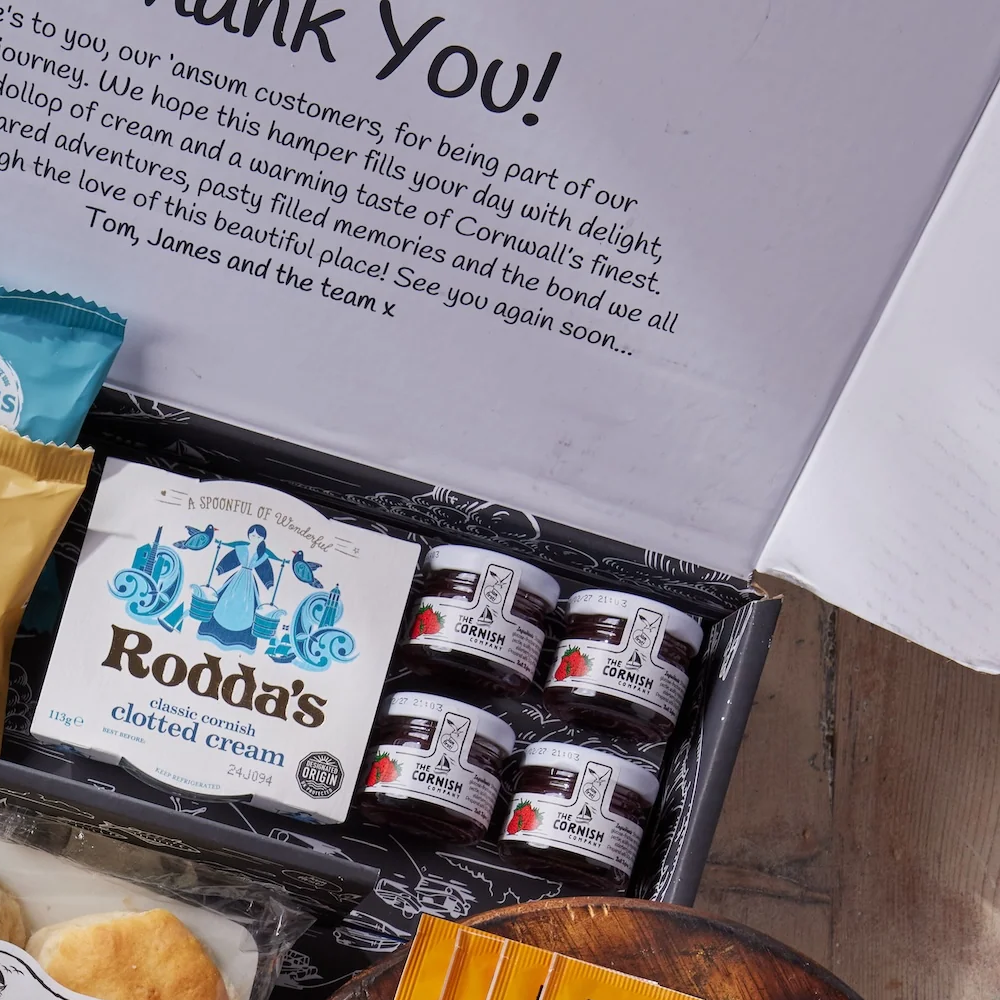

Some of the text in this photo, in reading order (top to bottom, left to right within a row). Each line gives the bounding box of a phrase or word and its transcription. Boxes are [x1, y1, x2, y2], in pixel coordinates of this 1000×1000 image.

[145, 0, 562, 126] ank You!
[32, 12, 56, 37] to
[60, 28, 109, 62] you,
[119, 46, 161, 68] our
[170, 53, 247, 97] 'ansum
[255, 87, 384, 144] customers,
[395, 122, 432, 150] for
[437, 135, 499, 177] being
[504, 164, 559, 190] part
[564, 178, 595, 199] of
[595, 190, 638, 212] our
[99, 70, 143, 101] We
[151, 85, 208, 120] hope
[217, 105, 260, 136] this
[268, 120, 358, 164] hamper
[364, 149, 406, 180] fills
[408, 171, 468, 197] your
[473, 184, 514, 219] day
[521, 203, 571, 231] with
[579, 216, 662, 264] delight,
[70, 101, 99, 122] of
[101, 113, 173, 147] cream
[180, 137, 225, 161] and
[229, 152, 241, 168] a
[250, 158, 347, 203] warming
[357, 184, 417, 219] taste
[424, 208, 454, 228] of
[455, 216, 583, 269] Cornwall's
[591, 254, 660, 295] finest.
[55, 132, 189, 193] adventures,
[198, 178, 262, 214] pasty
[271, 193, 330, 228] filled
[333, 219, 446, 263] memories
[452, 255, 498, 278] and
[502, 263, 539, 290] the
[546, 276, 606, 310] bond
[608, 302, 642, 321] we
[648, 311, 678, 333] all
[33, 156, 71, 184] the
[79, 169, 126, 201] love
[133, 191, 162, 210] of
[164, 196, 207, 225] this
[214, 210, 315, 258] beautiful
[318, 247, 390, 281] place!
[394, 267, 440, 295] See
[443, 287, 488, 309] you
[493, 302, 553, 331] again
[559, 322, 632, 356] soon...
[86, 206, 396, 317] Tom, James and the team x
[188, 496, 333, 553] A SPOONFUL OF Wonderful
[455, 622, 506, 646] CORNISH
[459, 615, 474, 624] THE
[100, 623, 328, 728] Rodda's
[602, 666, 654, 690] CORNISH
[607, 658, 622, 667] THE
[102, 727, 118, 737] BEST
[150, 698, 257, 737] classic cornish
[111, 702, 285, 768] clotted cream
[227, 764, 273, 786] 24J094
[302, 767, 338, 786] ORIGIN
[412, 770, 463, 794] CORNISH
[416, 763, 431, 772] THE
[553, 820, 604, 843] CORNISH
[558, 812, 573, 821] THE
